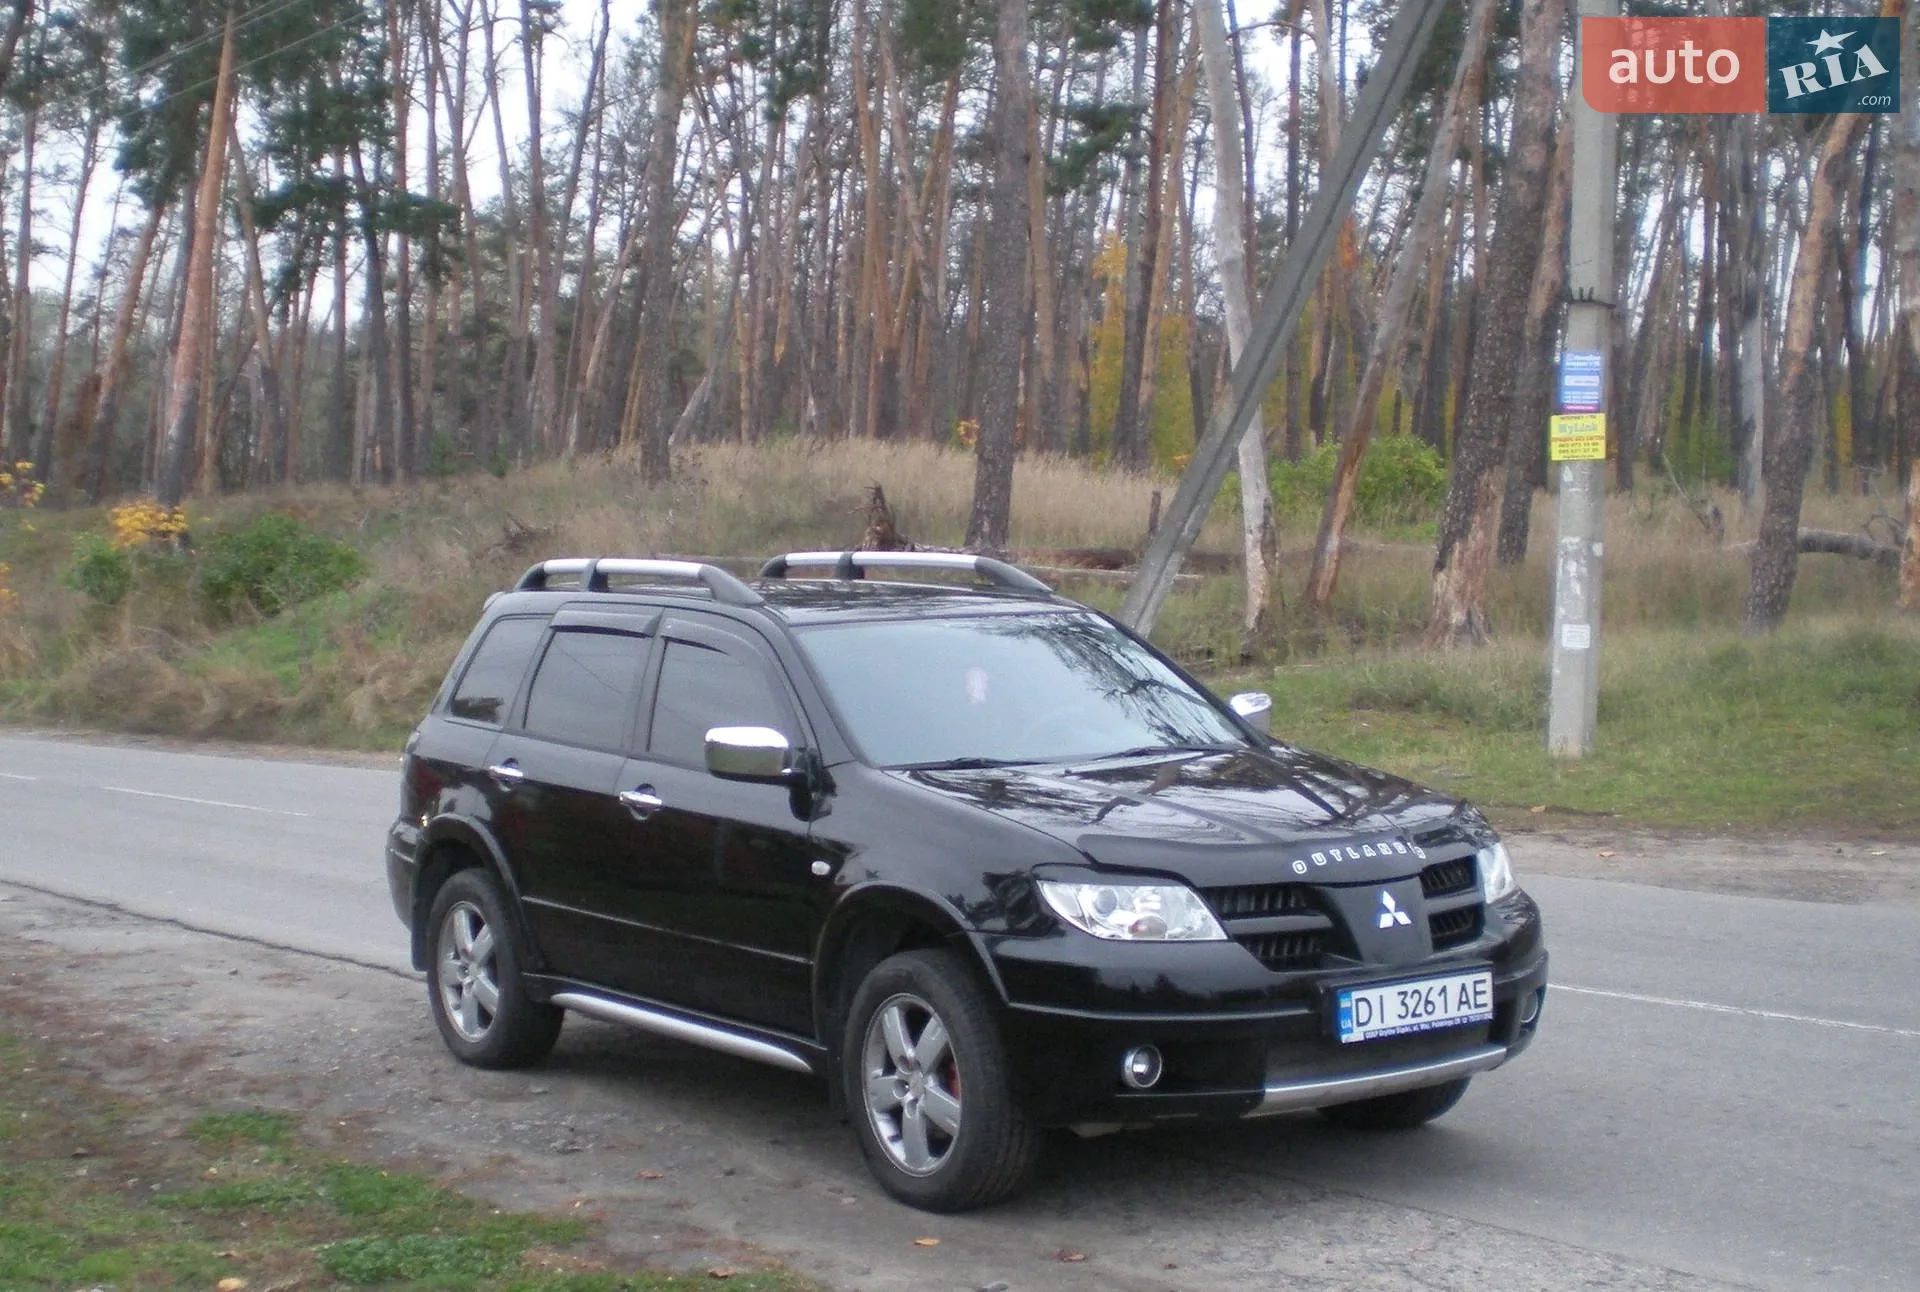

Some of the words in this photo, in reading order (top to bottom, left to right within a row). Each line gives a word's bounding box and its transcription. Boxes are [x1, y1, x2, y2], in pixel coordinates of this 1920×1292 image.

[1354, 994, 1385, 1028] DI
[1397, 984, 1449, 1020] 3261
[1456, 978, 1489, 1012] AE
